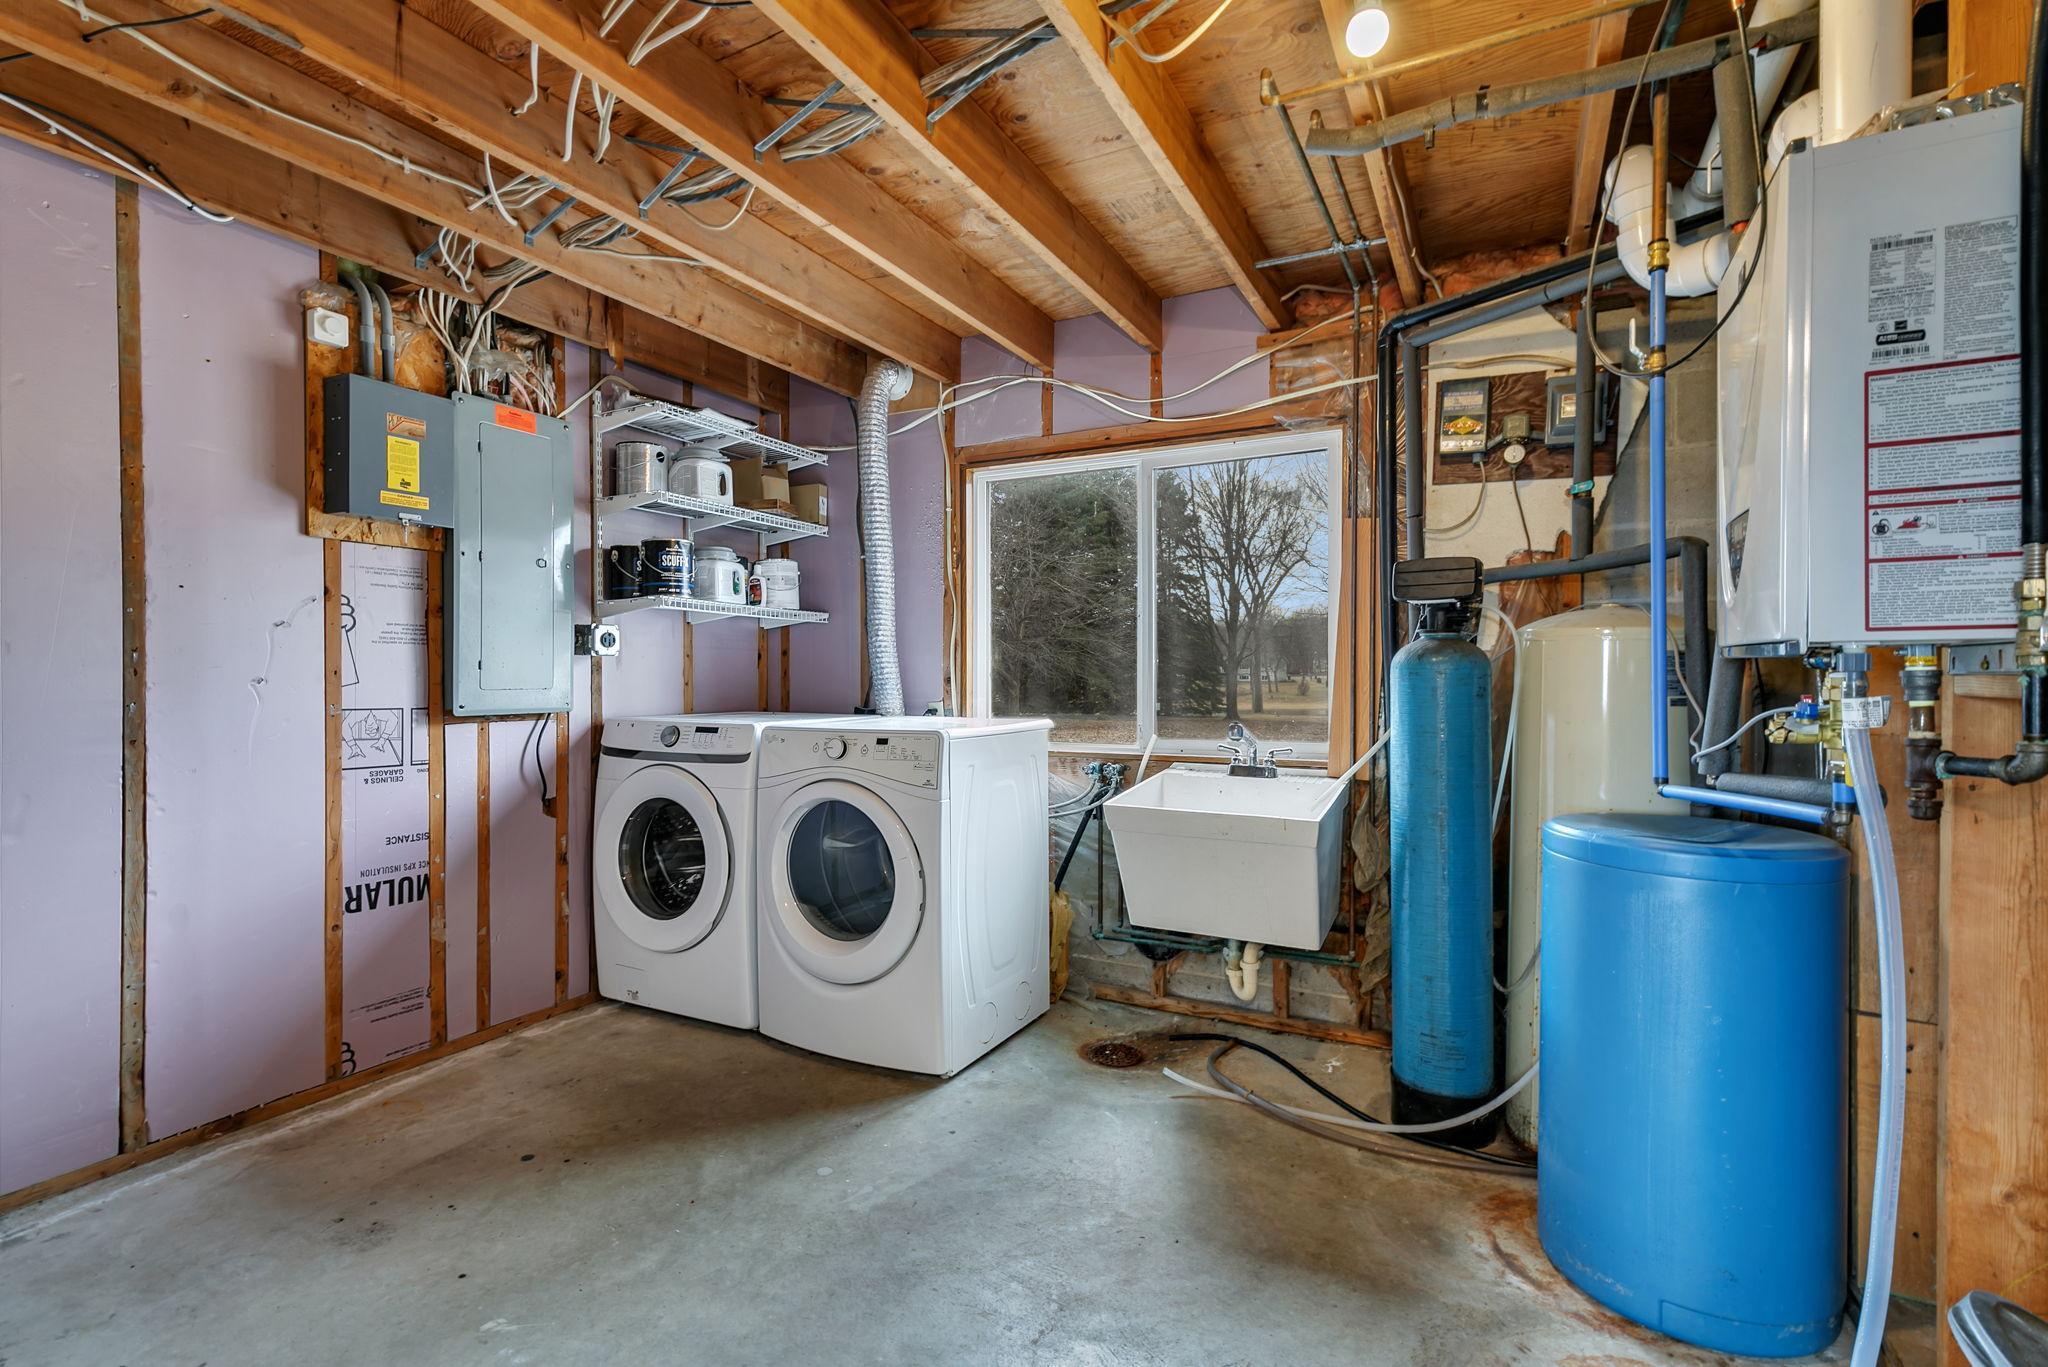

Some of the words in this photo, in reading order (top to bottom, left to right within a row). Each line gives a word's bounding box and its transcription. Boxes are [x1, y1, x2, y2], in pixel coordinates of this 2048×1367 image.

[369, 768, 404, 777] GARAGES
[370, 776, 404, 784] CEILINGS
[385, 831, 430, 846] SISTANCE
[360, 864, 402, 878] INSULATION
[403, 861, 417, 871] XPS
